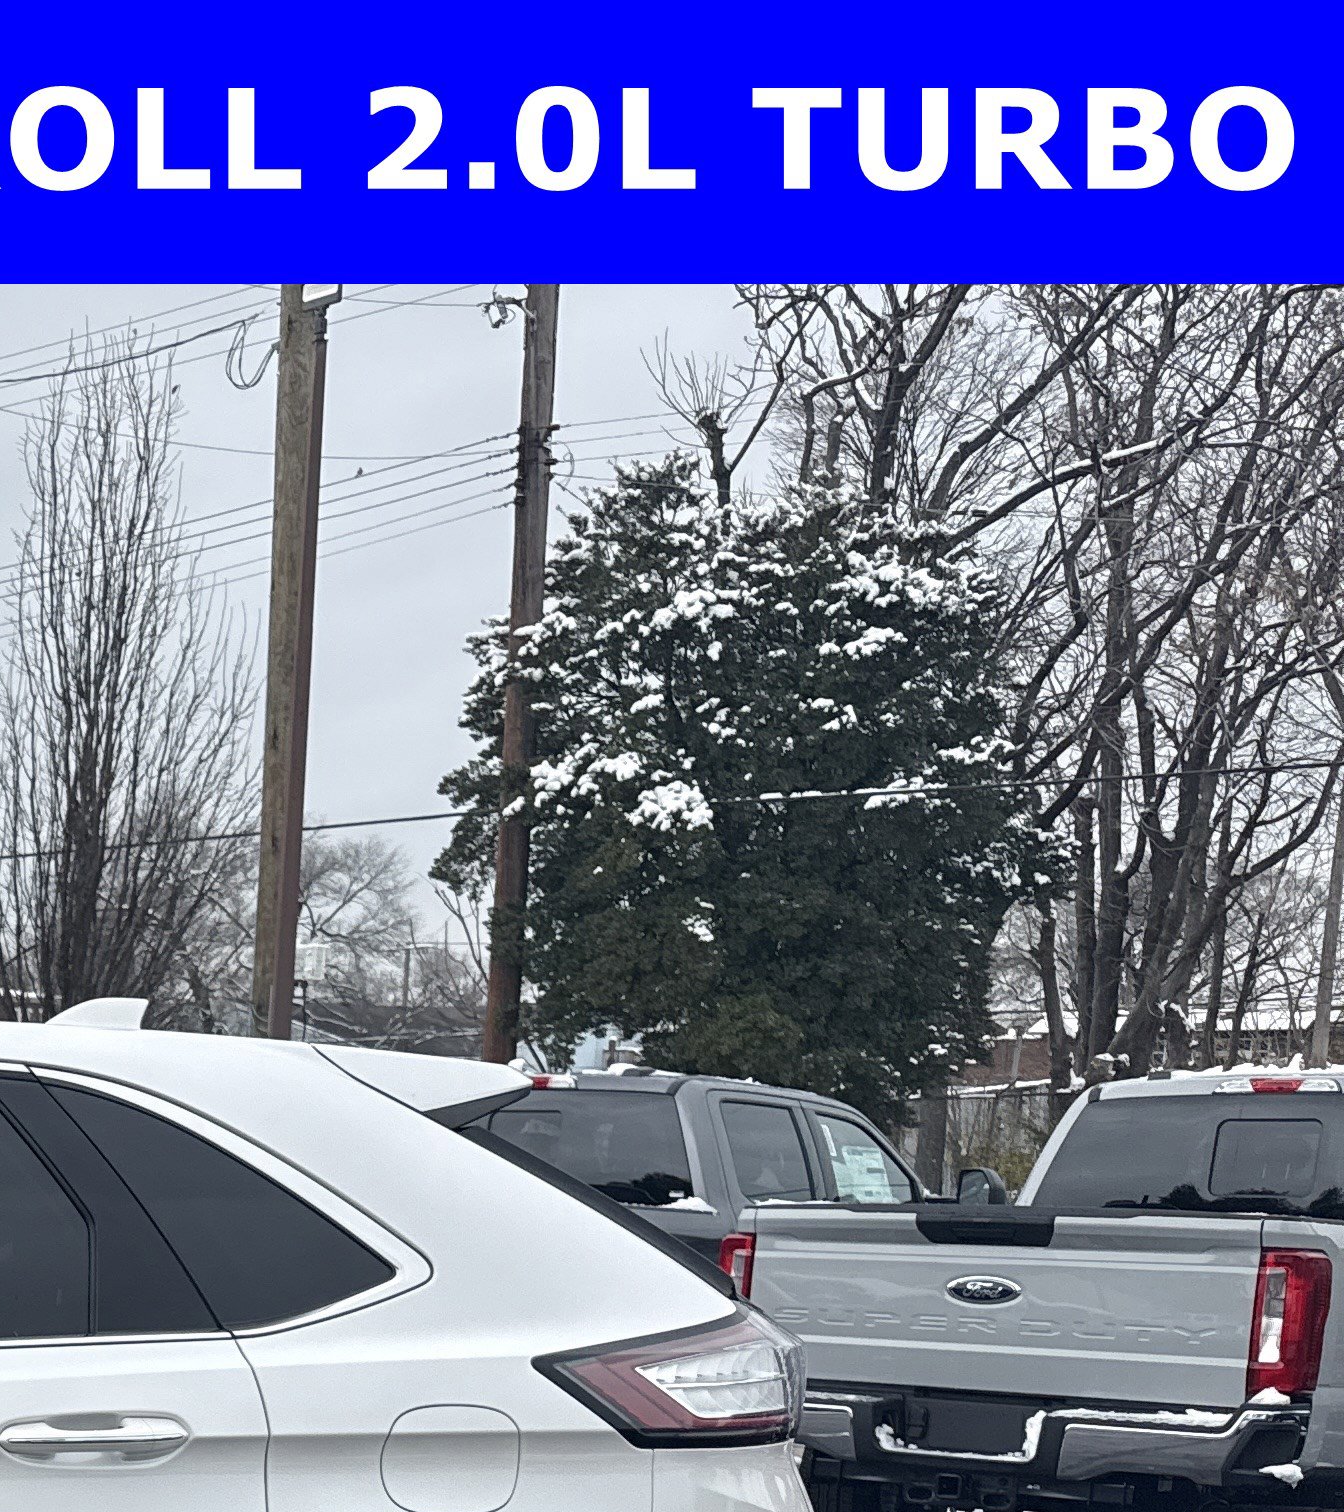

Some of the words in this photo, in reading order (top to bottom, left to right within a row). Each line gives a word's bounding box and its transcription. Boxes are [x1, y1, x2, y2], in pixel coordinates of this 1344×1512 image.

[962, 1281, 1003, 1298] Ford
[773, 1306, 998, 1334] SUPER
[1019, 1318, 1217, 1345] DUTY
